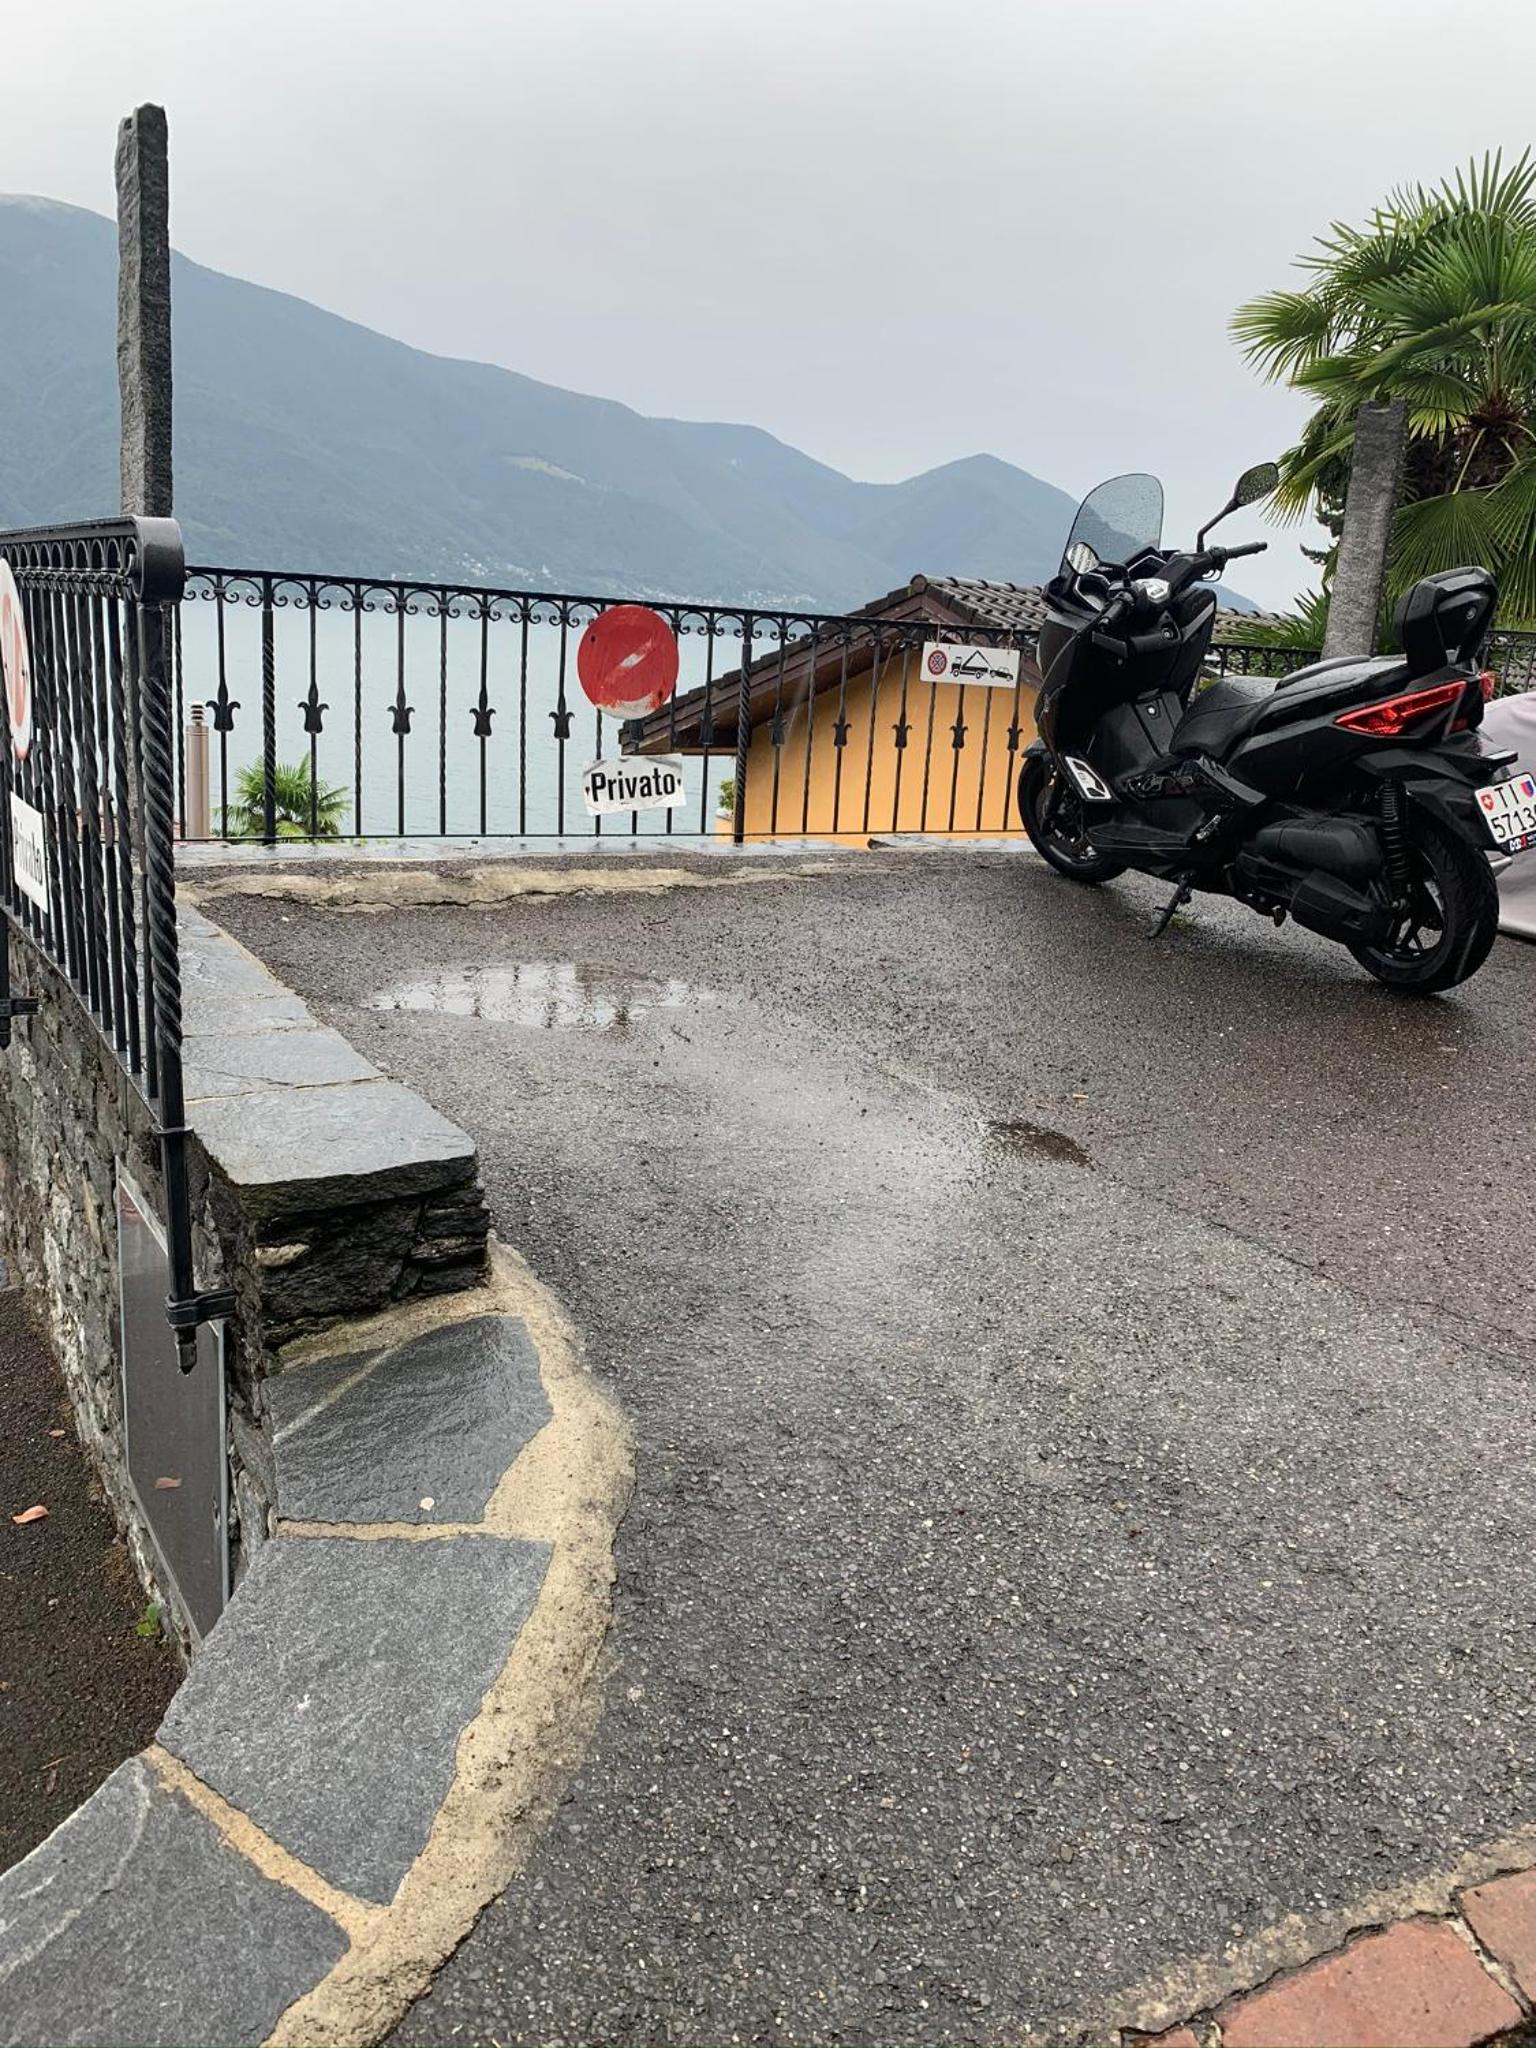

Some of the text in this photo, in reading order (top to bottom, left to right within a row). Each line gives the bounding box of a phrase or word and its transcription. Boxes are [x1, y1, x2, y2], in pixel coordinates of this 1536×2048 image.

[591, 767, 675, 802] Privato
[1494, 783, 1519, 808] TI
[1490, 804, 1536, 838] 5713
